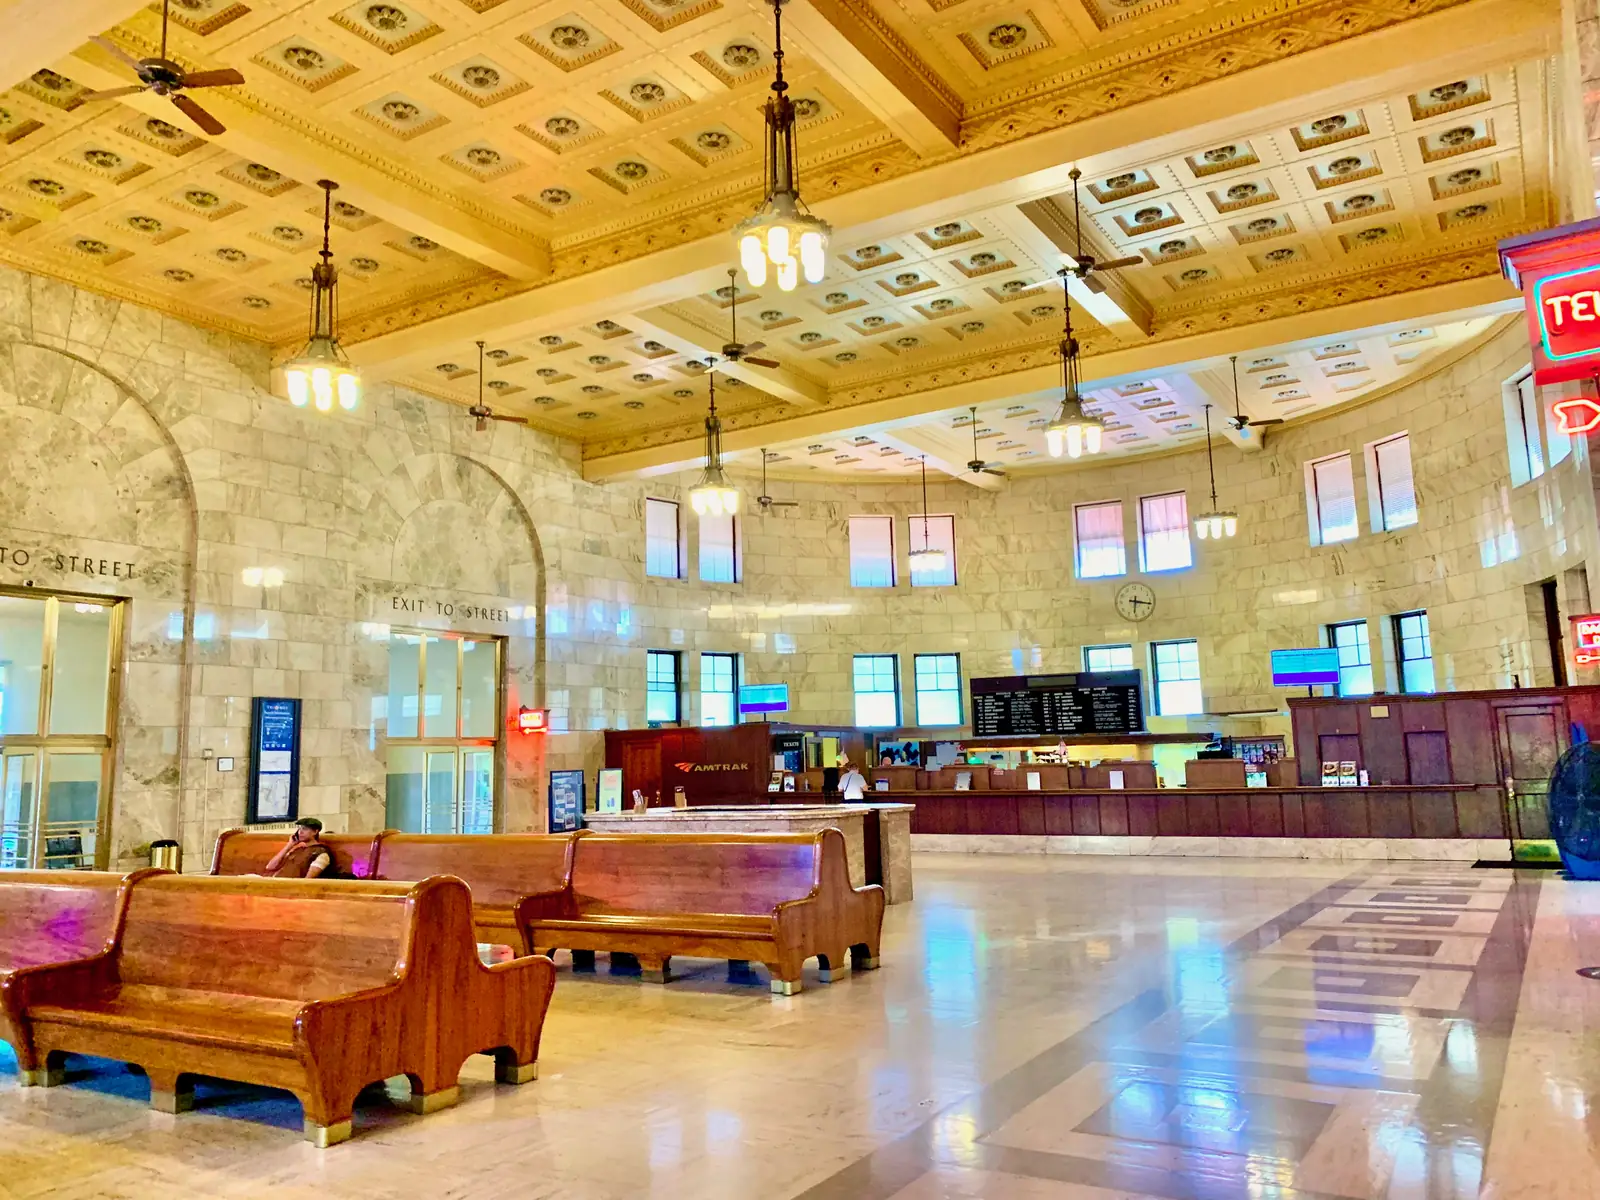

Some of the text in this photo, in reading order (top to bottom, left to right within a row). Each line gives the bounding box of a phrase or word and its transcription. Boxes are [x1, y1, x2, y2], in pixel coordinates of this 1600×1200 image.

[0, 547, 135, 580] TO STREET
[392, 596, 509, 622] EXIT TO STREET
[694, 763, 748, 772] AMTRAK
